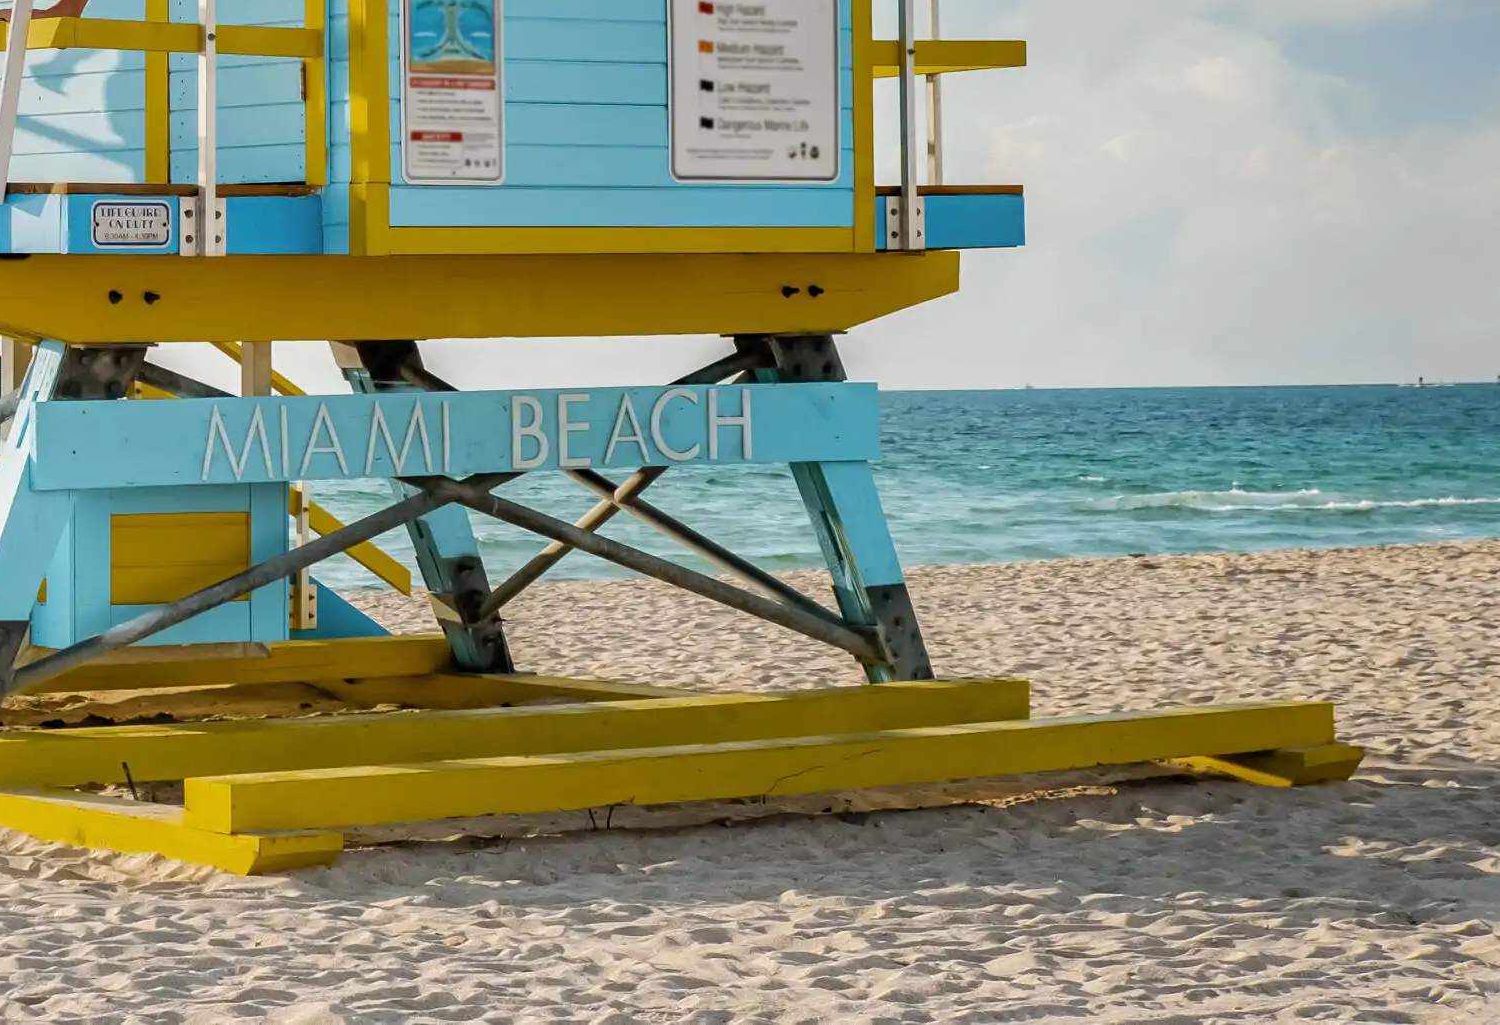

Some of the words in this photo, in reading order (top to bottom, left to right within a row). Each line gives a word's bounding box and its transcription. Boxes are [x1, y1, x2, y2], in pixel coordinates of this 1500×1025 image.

[109, 219, 123, 229] ON
[126, 219, 153, 229] DUTY
[202, 398, 451, 482] MIAMI
[511, 388, 753, 470] BEACH
